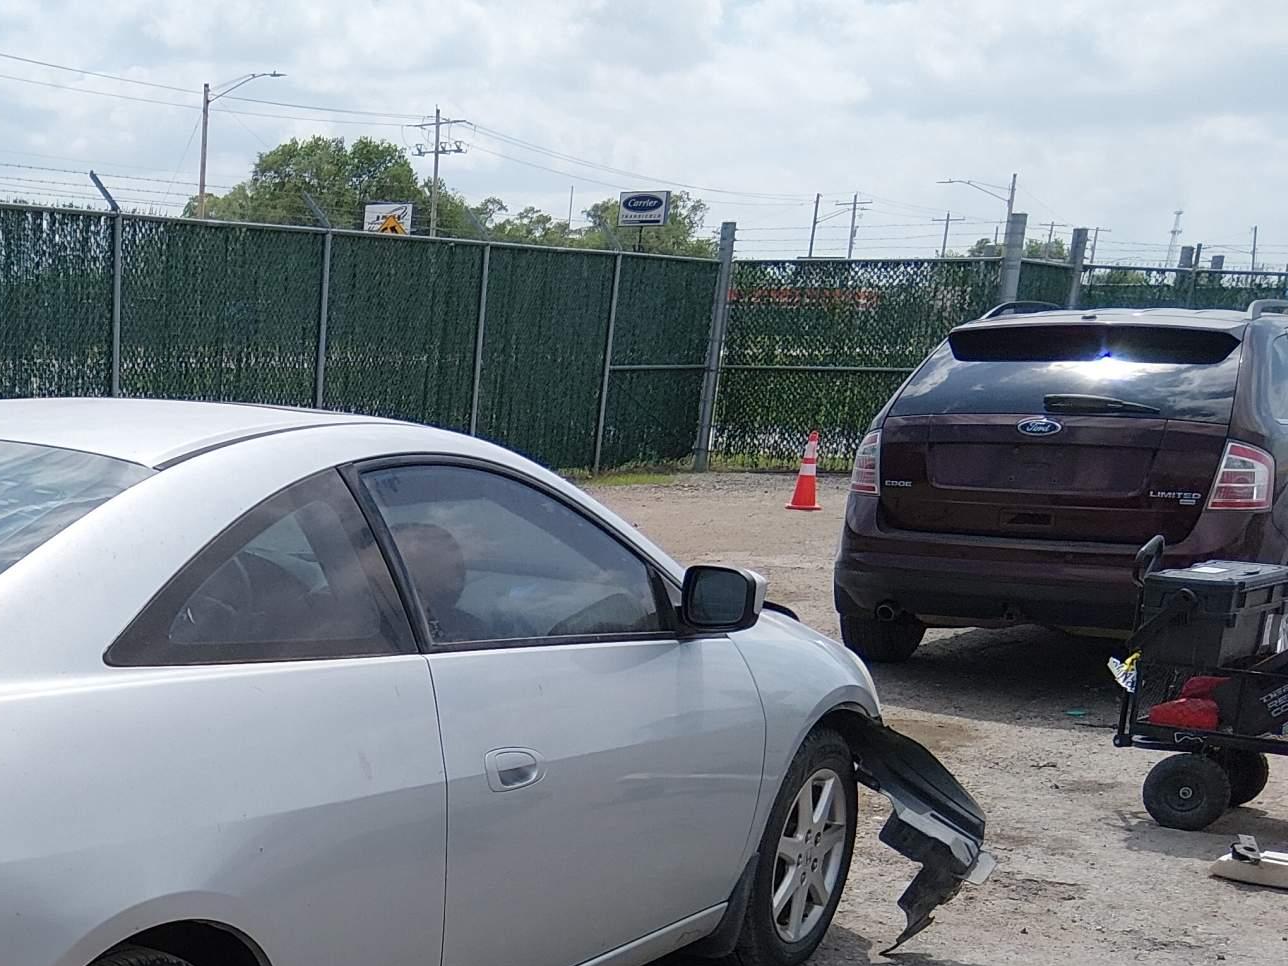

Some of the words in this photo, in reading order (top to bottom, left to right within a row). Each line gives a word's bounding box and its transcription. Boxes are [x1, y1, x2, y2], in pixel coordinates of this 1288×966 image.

[628, 199, 658, 207] Carrier
[1026, 421, 1052, 432] Ford
[1149, 490, 1202, 499] LIMITED
